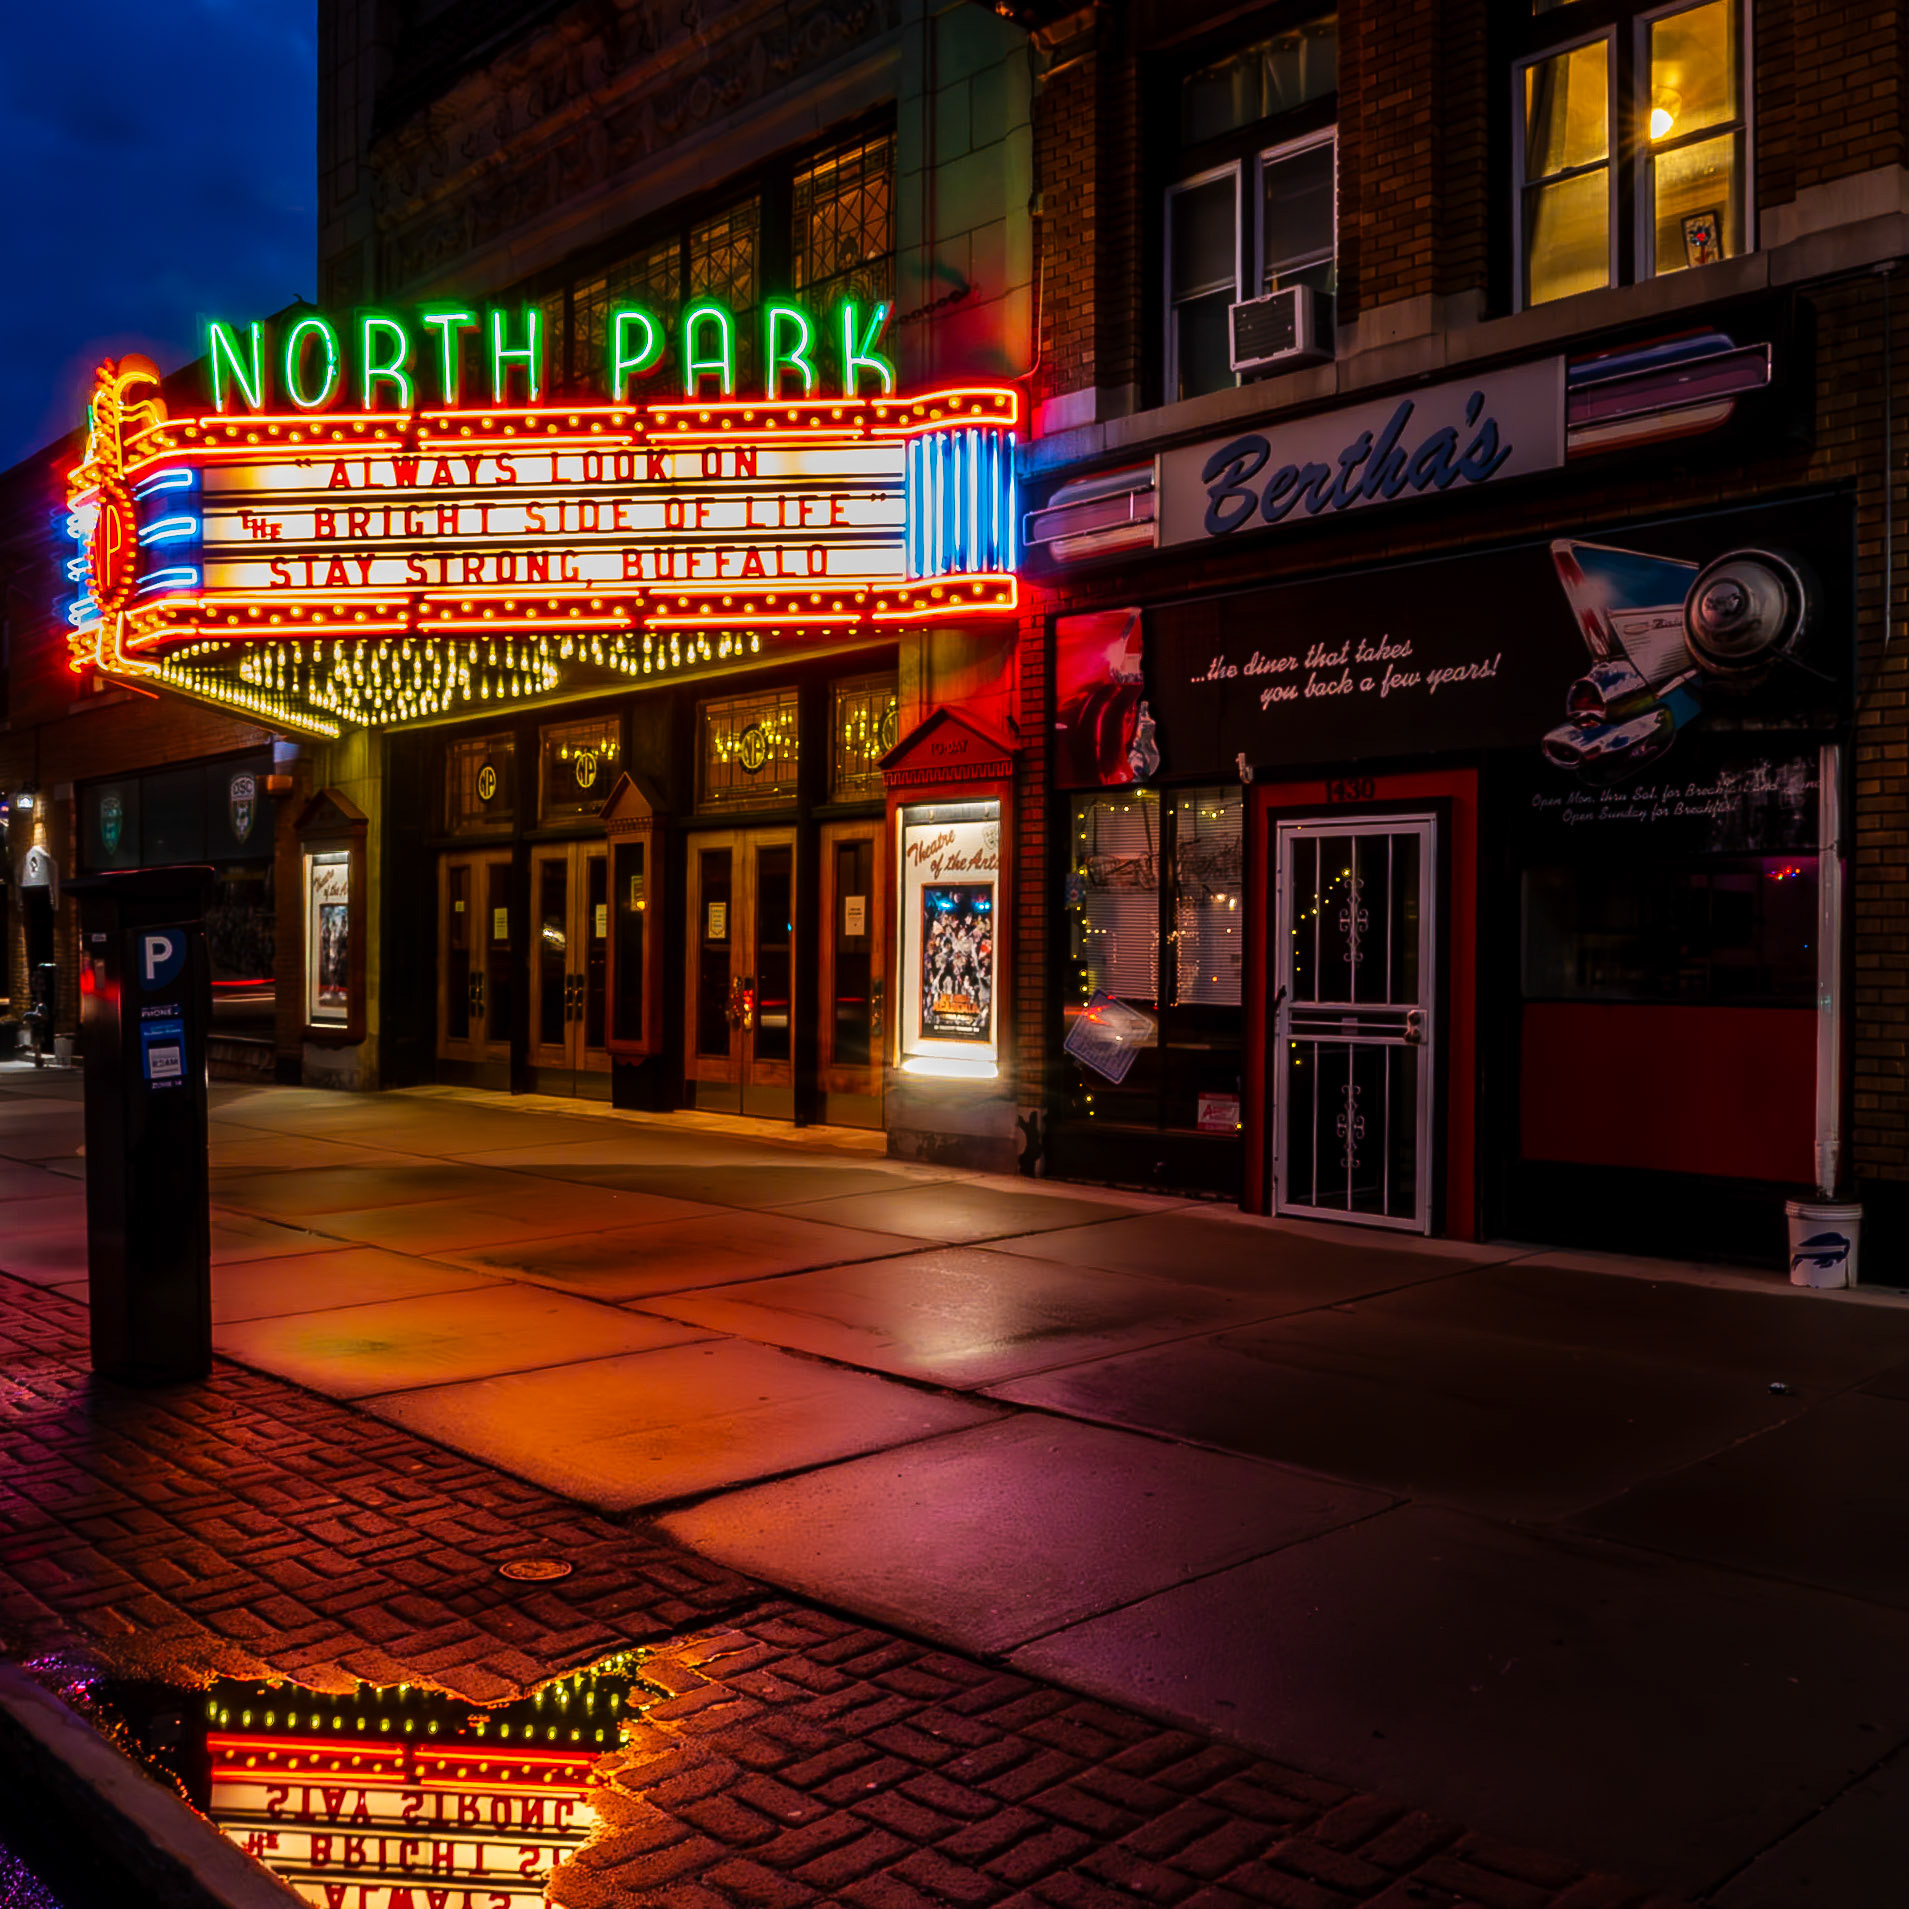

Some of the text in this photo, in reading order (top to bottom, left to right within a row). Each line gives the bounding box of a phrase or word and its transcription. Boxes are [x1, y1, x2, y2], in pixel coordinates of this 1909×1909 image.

[208, 300, 894, 412] NORTH PARK
[551, 448, 669, 482] LOOK
[701, 446, 758, 478] ON
[1202, 391, 1512, 535] Bertha's
[240, 510, 283, 540] THE
[314, 503, 497, 539] BRIGHT
[525, 498, 633, 533] SIDE
[664, 497, 716, 530] OF
[269, 554, 376, 588] STAY
[622, 544, 828, 579] BUFFALO
[1243, 650, 1299, 677] diner
[1303, 640, 1350, 669] that
[1354, 632, 1414, 664] takes
[1259, 651, 1502, 711] you back a few years!
[1530, 793, 1561, 813] Open
[1562, 807, 1594, 828] Open
[1598, 806, 1647, 824] Sunday
[907, 829, 956, 868] Theatre
[930, 853, 945, 880] of
[944, 849, 968, 871] the
[145, 935, 174, 980] P
